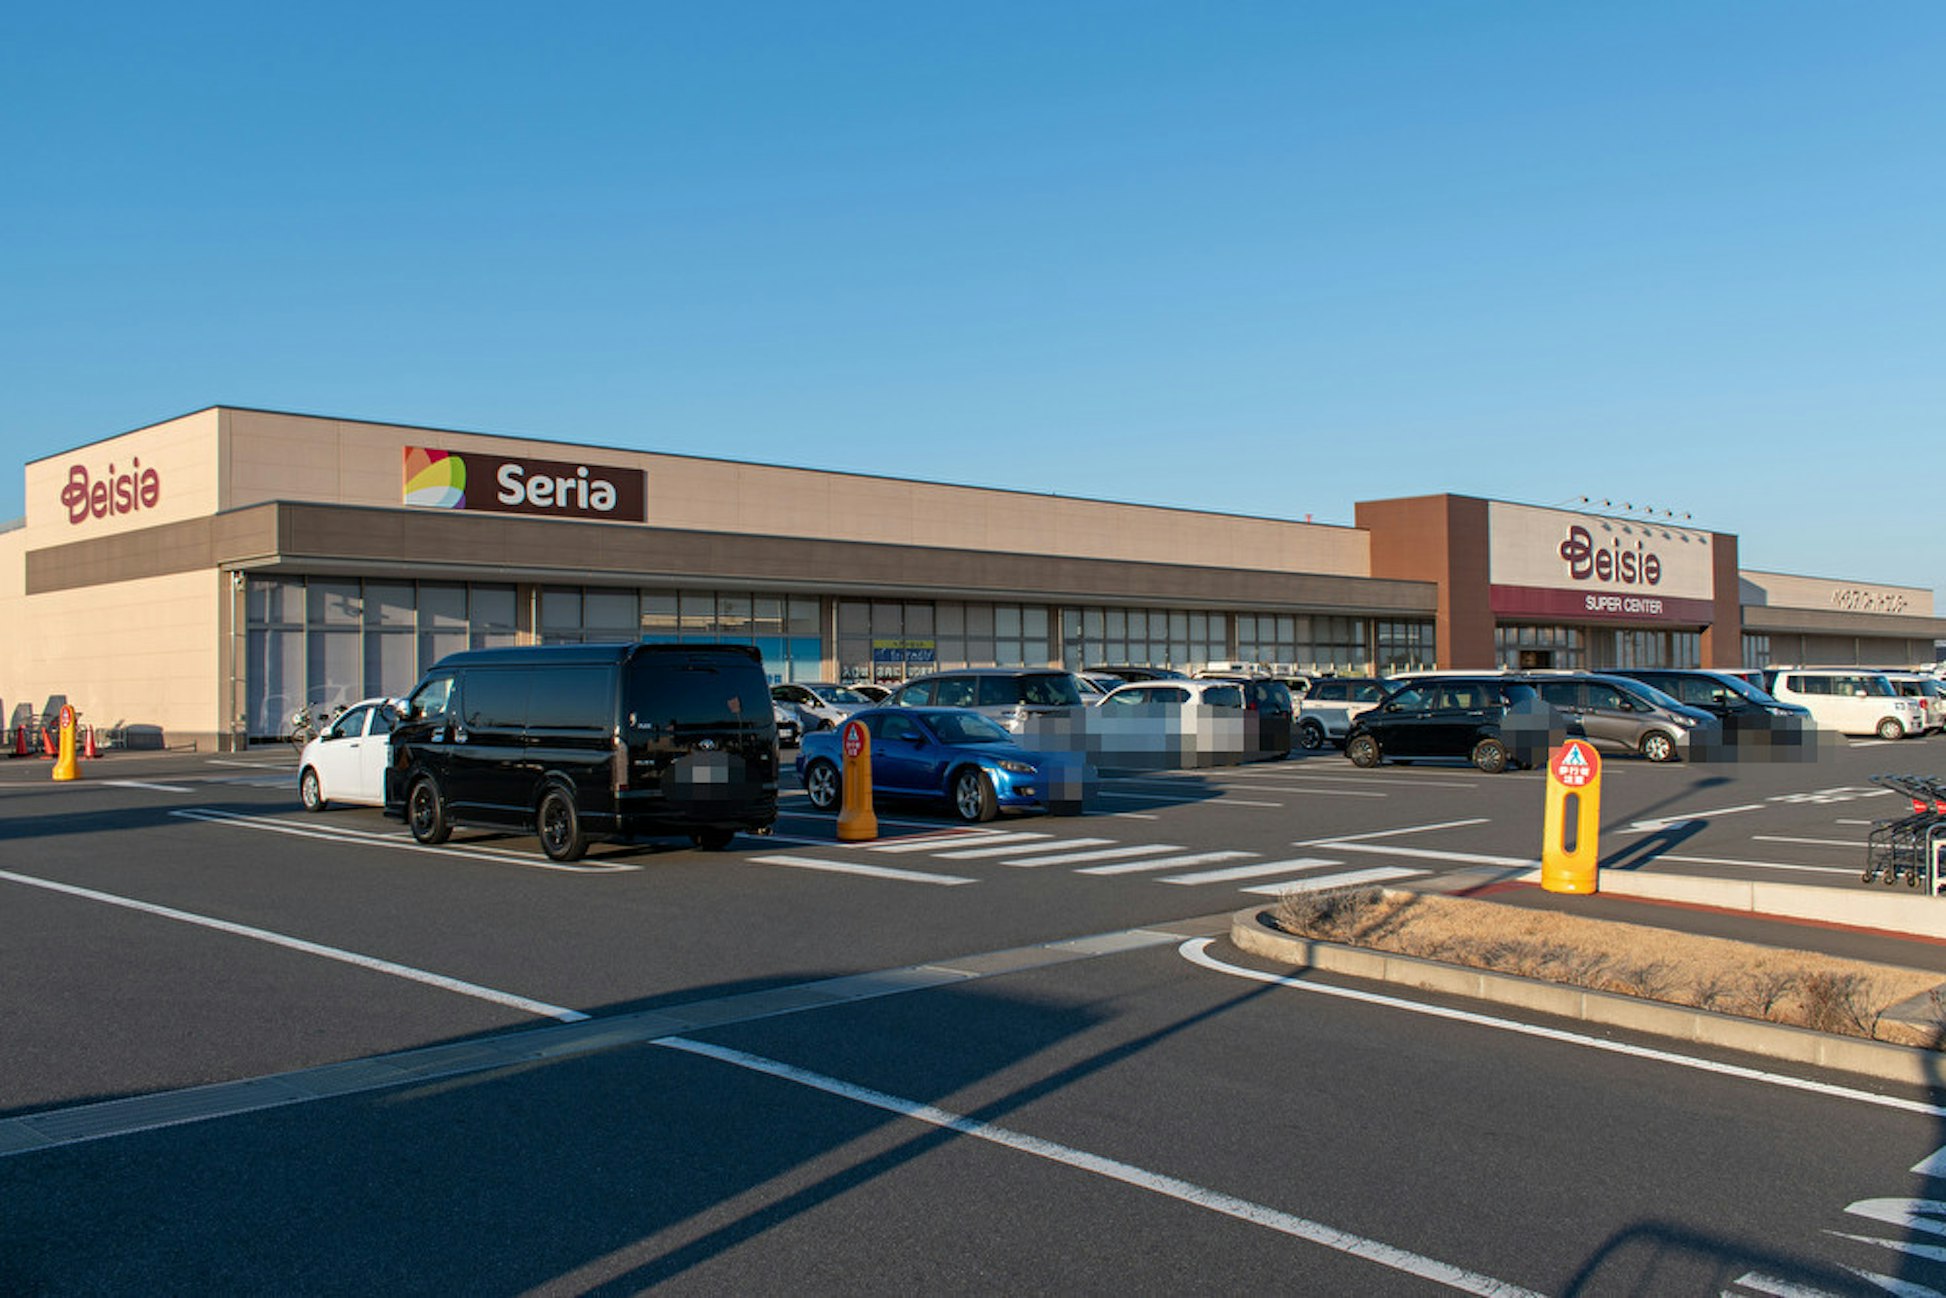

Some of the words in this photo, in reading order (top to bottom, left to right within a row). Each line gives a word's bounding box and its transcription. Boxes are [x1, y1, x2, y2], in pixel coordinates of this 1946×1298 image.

[61, 456, 159, 525] Beisia
[497, 463, 617, 512] Seria
[1560, 525, 1661, 586] Beisia
[1585, 595, 1622, 612] SUPER
[1623, 598, 1663, 615] CENTER
